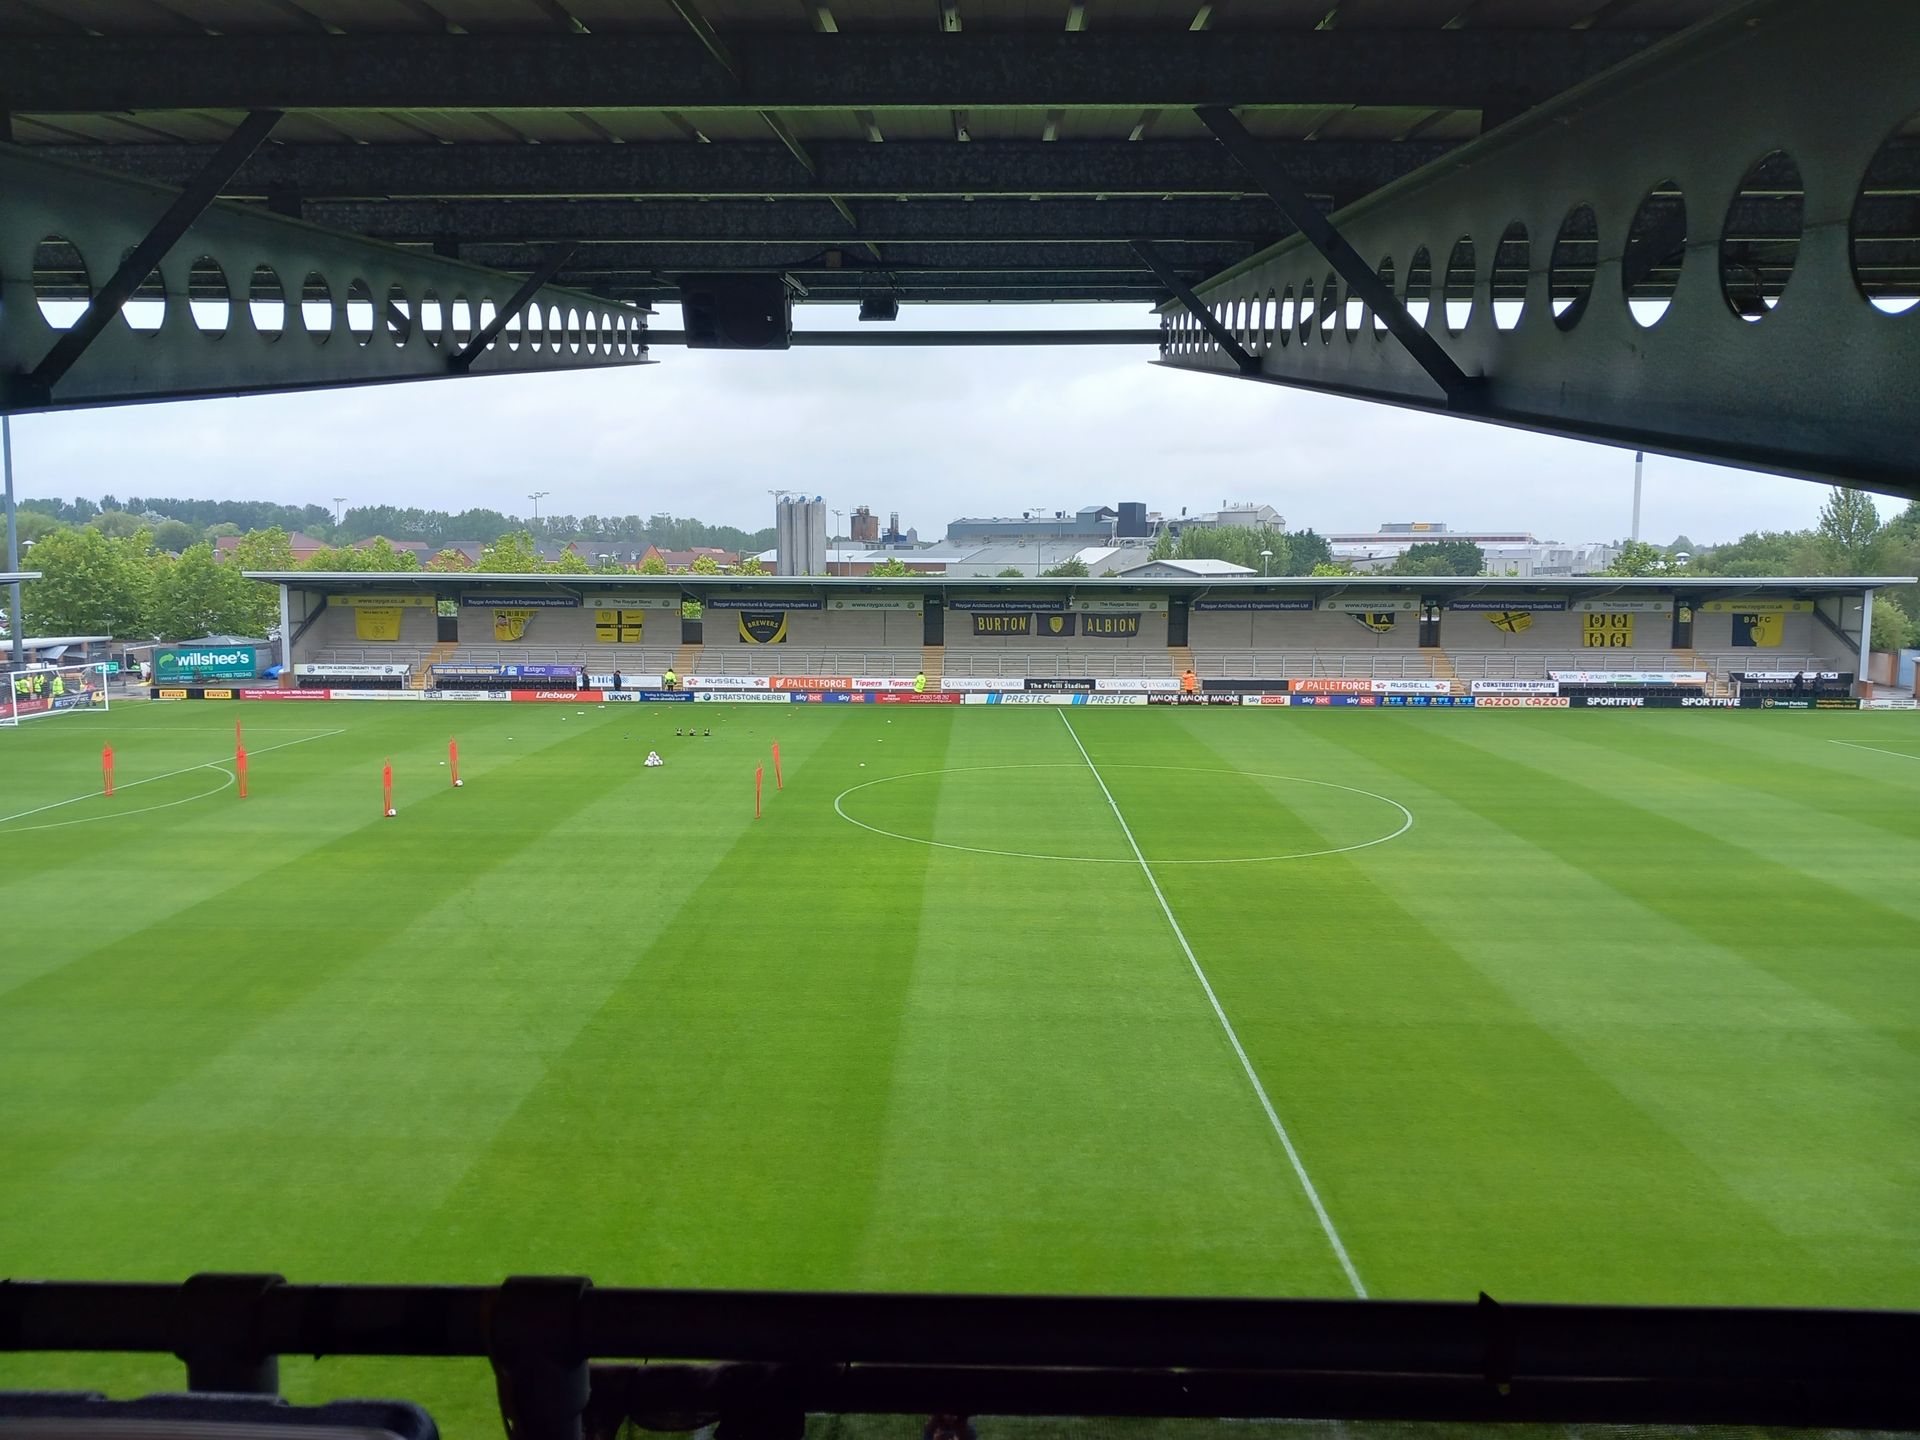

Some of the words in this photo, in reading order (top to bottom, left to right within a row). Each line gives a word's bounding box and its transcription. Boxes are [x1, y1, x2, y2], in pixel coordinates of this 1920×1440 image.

[1380, 614, 1389, 623] A
[748, 620, 778, 628] BREWERS
[978, 617, 1026, 631] BURTON
[1088, 618, 1135, 632] ALBION
[177, 651, 249, 666] willshee's
[787, 679, 846, 688] PALLETFORCE
[1307, 682, 1370, 690] PALLETFORCE
[1005, 695, 1050, 703] PRESTEC
[1302, 696, 1314, 704] sky
[1682, 698, 1741, 706] SPORTFIVE
